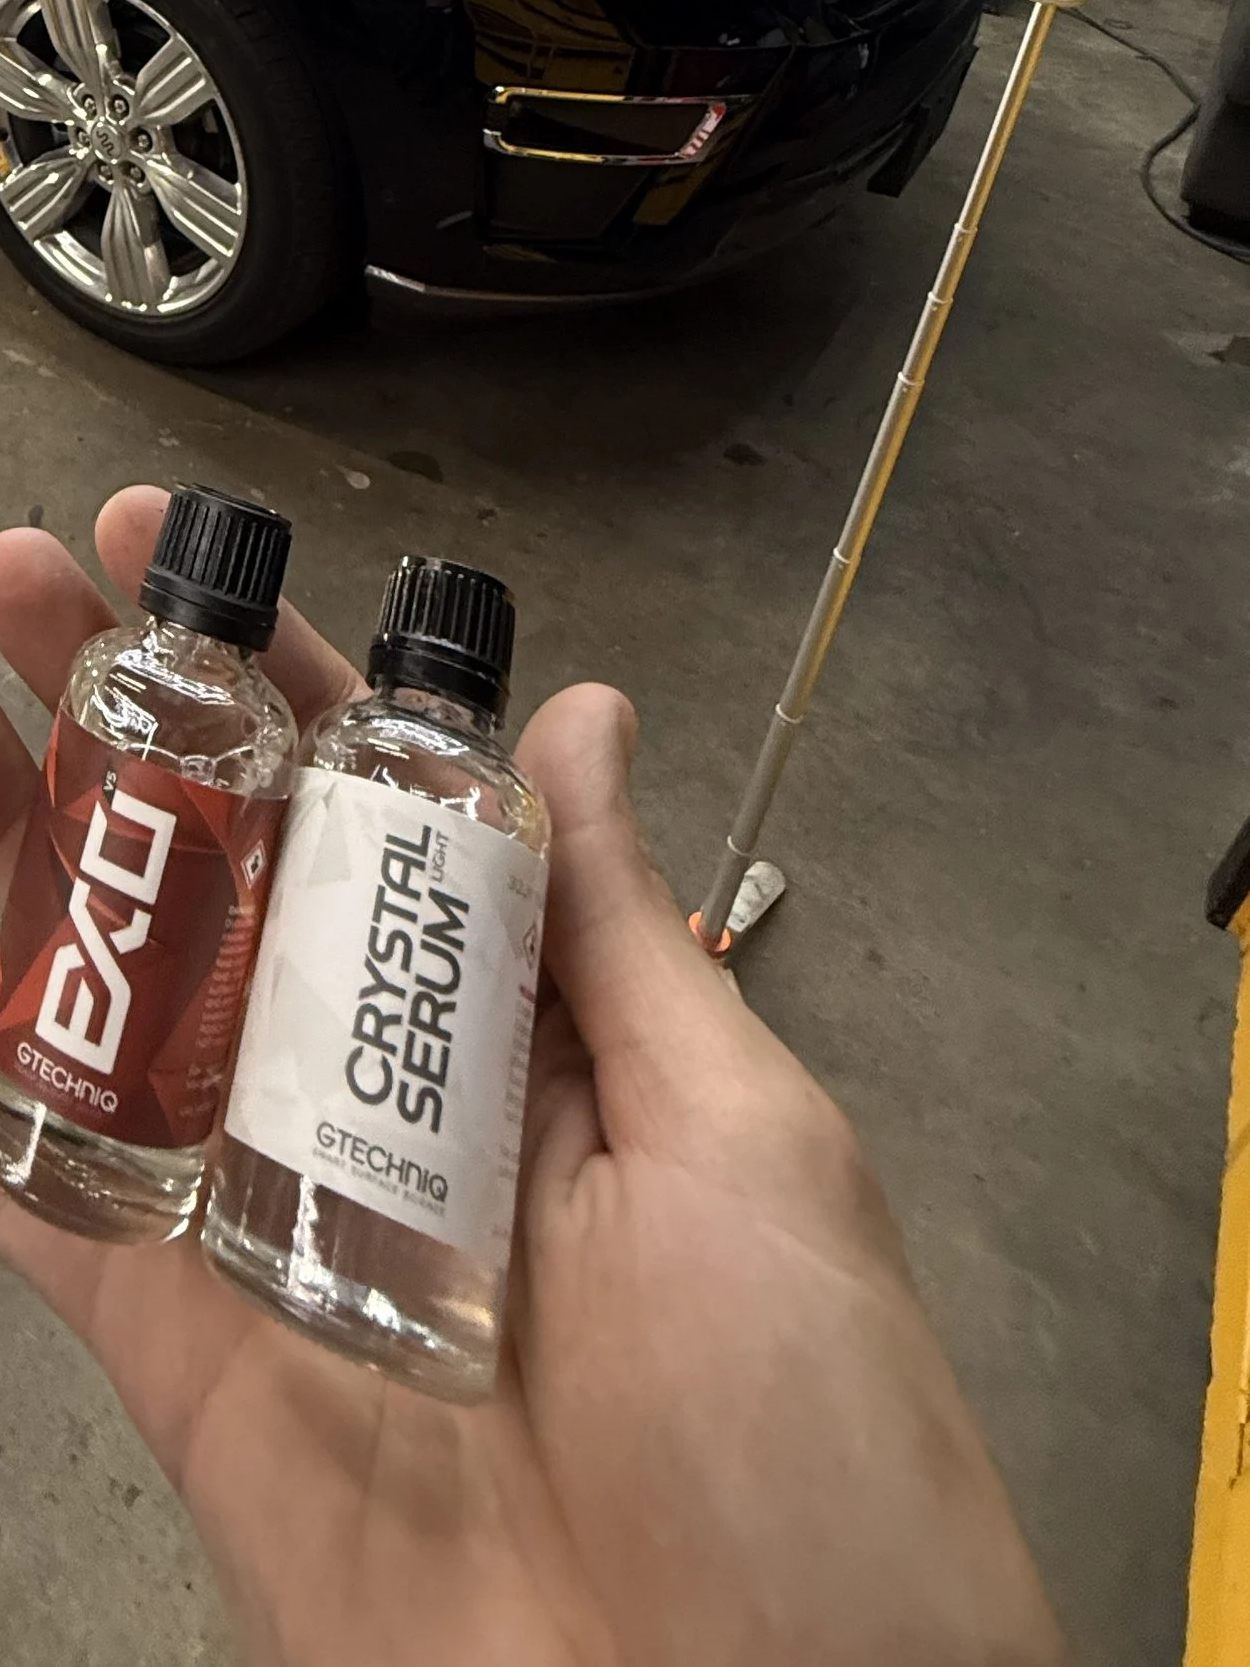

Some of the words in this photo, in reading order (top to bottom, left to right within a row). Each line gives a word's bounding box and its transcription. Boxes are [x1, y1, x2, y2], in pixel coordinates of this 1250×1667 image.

[35, 789, 177, 1075] EXO
[345, 824, 431, 1106] CRYSTAL
[430, 830, 450, 883] LIGHT
[396, 887, 470, 1135] SERUM
